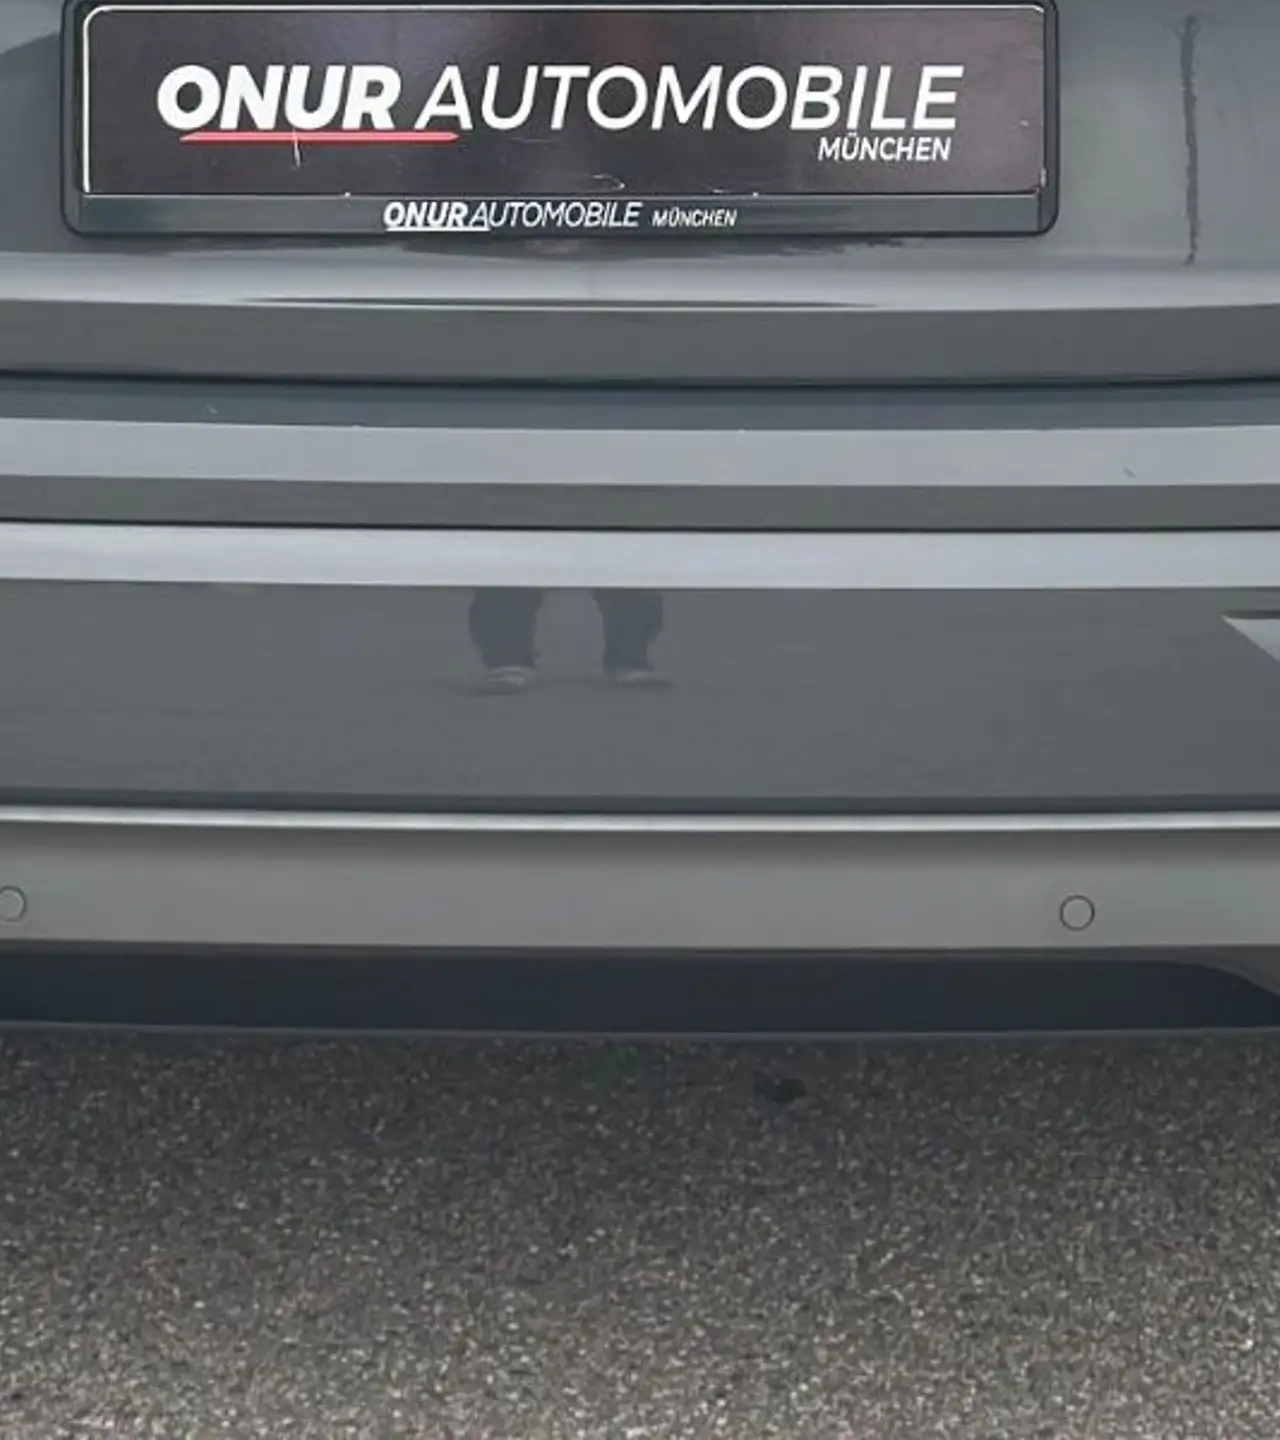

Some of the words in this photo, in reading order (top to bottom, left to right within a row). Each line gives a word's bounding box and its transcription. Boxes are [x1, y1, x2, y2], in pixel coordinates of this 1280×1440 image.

[157, 64, 402, 130] ONUR
[414, 64, 965, 131] AUTOMOBILE
[817, 132, 952, 162] MÜNCHEN
